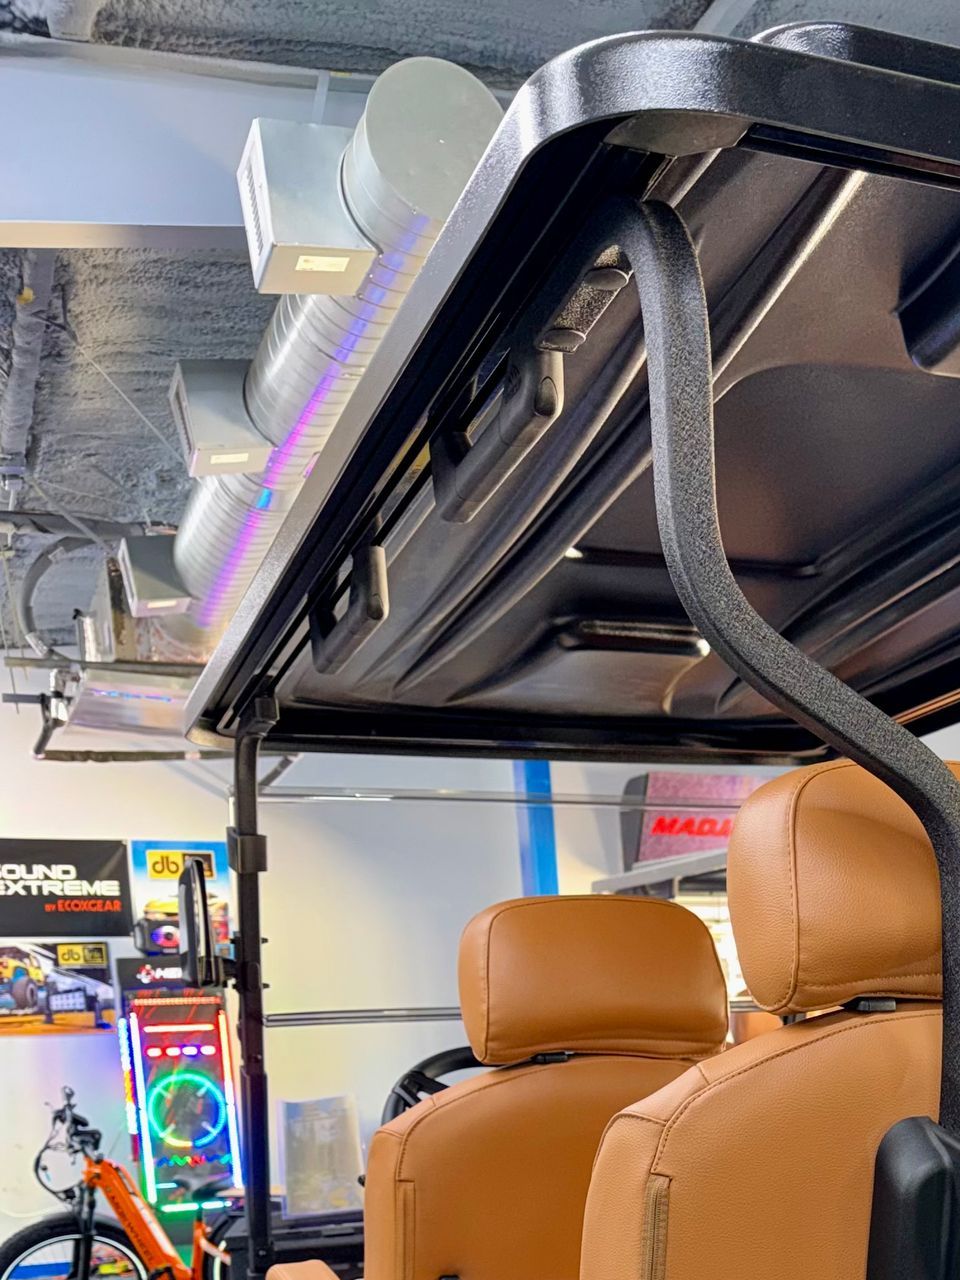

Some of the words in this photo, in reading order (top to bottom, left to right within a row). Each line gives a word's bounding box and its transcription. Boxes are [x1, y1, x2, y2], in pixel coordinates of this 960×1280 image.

[651, 816, 731, 836] MADJ
[0, 864, 77, 881] OUND
[57, 899, 122, 912] ECOXGEAR
